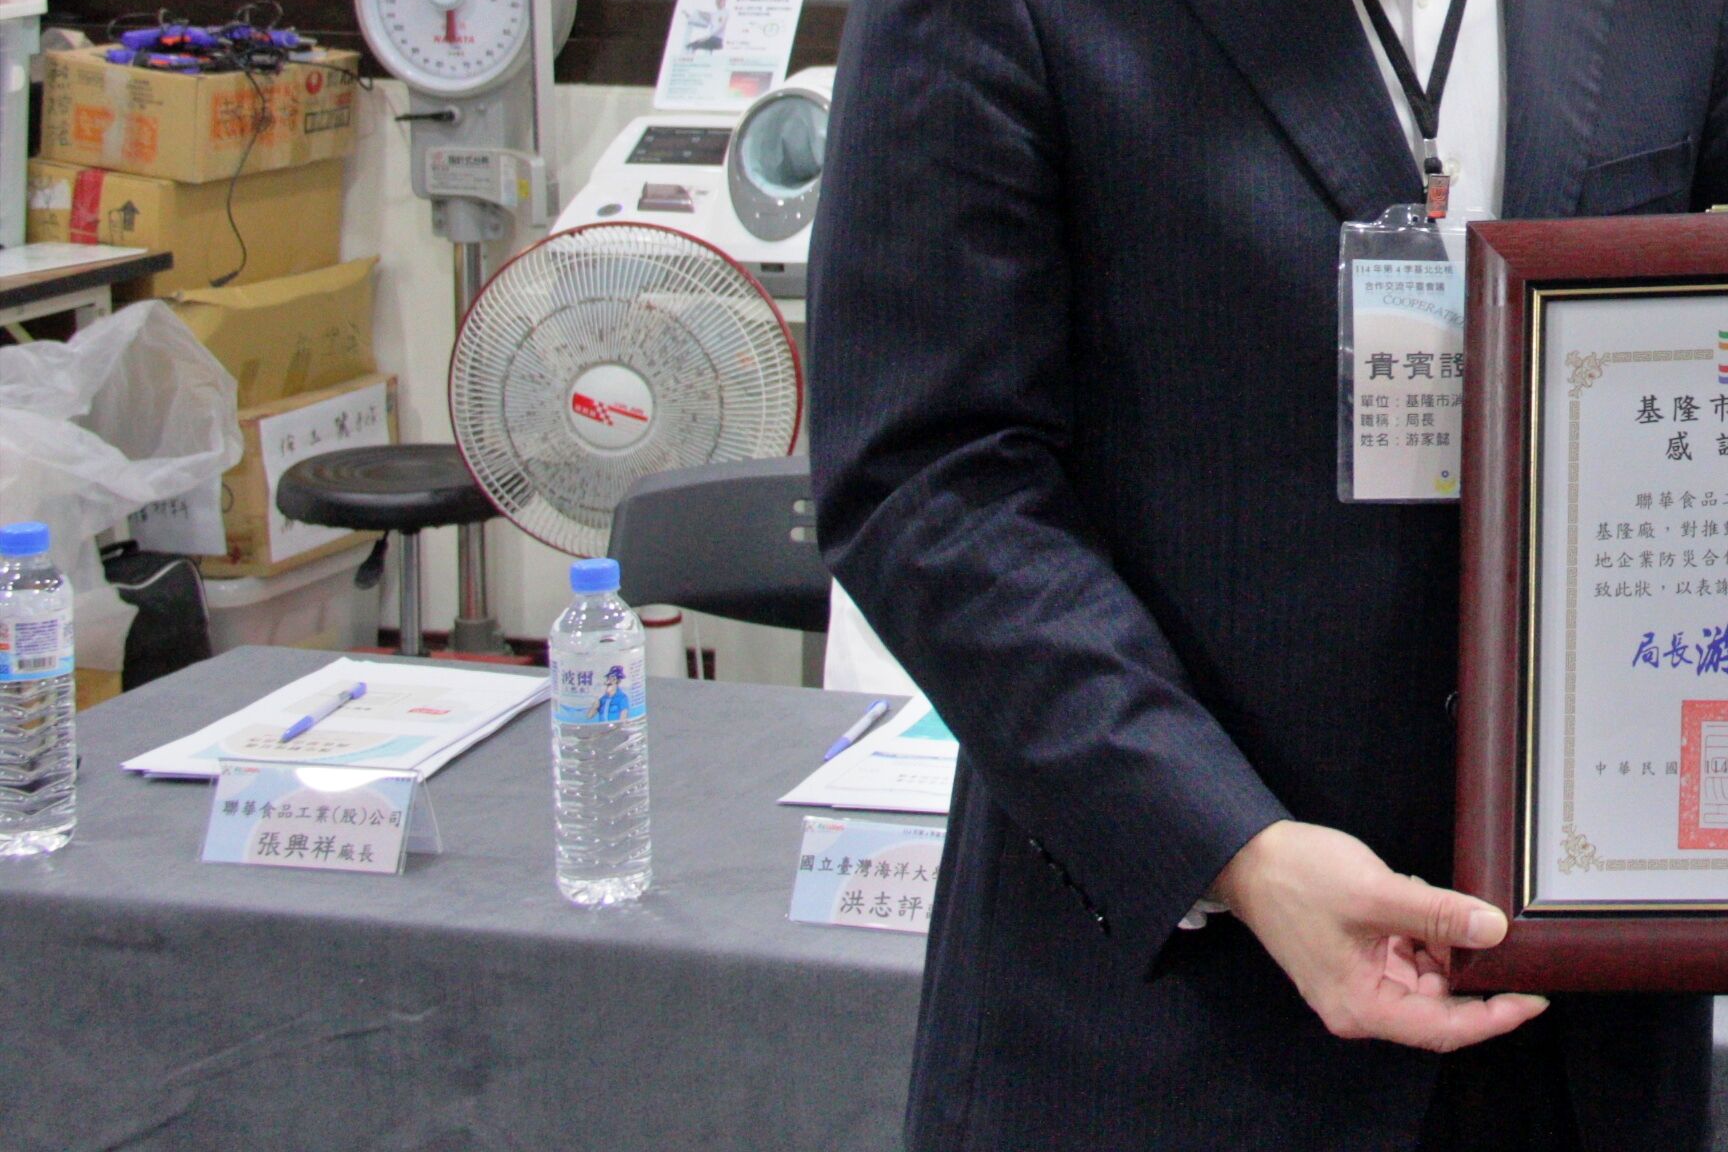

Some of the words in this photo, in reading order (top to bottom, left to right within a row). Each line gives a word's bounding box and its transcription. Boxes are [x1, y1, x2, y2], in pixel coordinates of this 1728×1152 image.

[562, 669, 593, 686] 波爾
[1595, 761, 1678, 777] 中華民國
